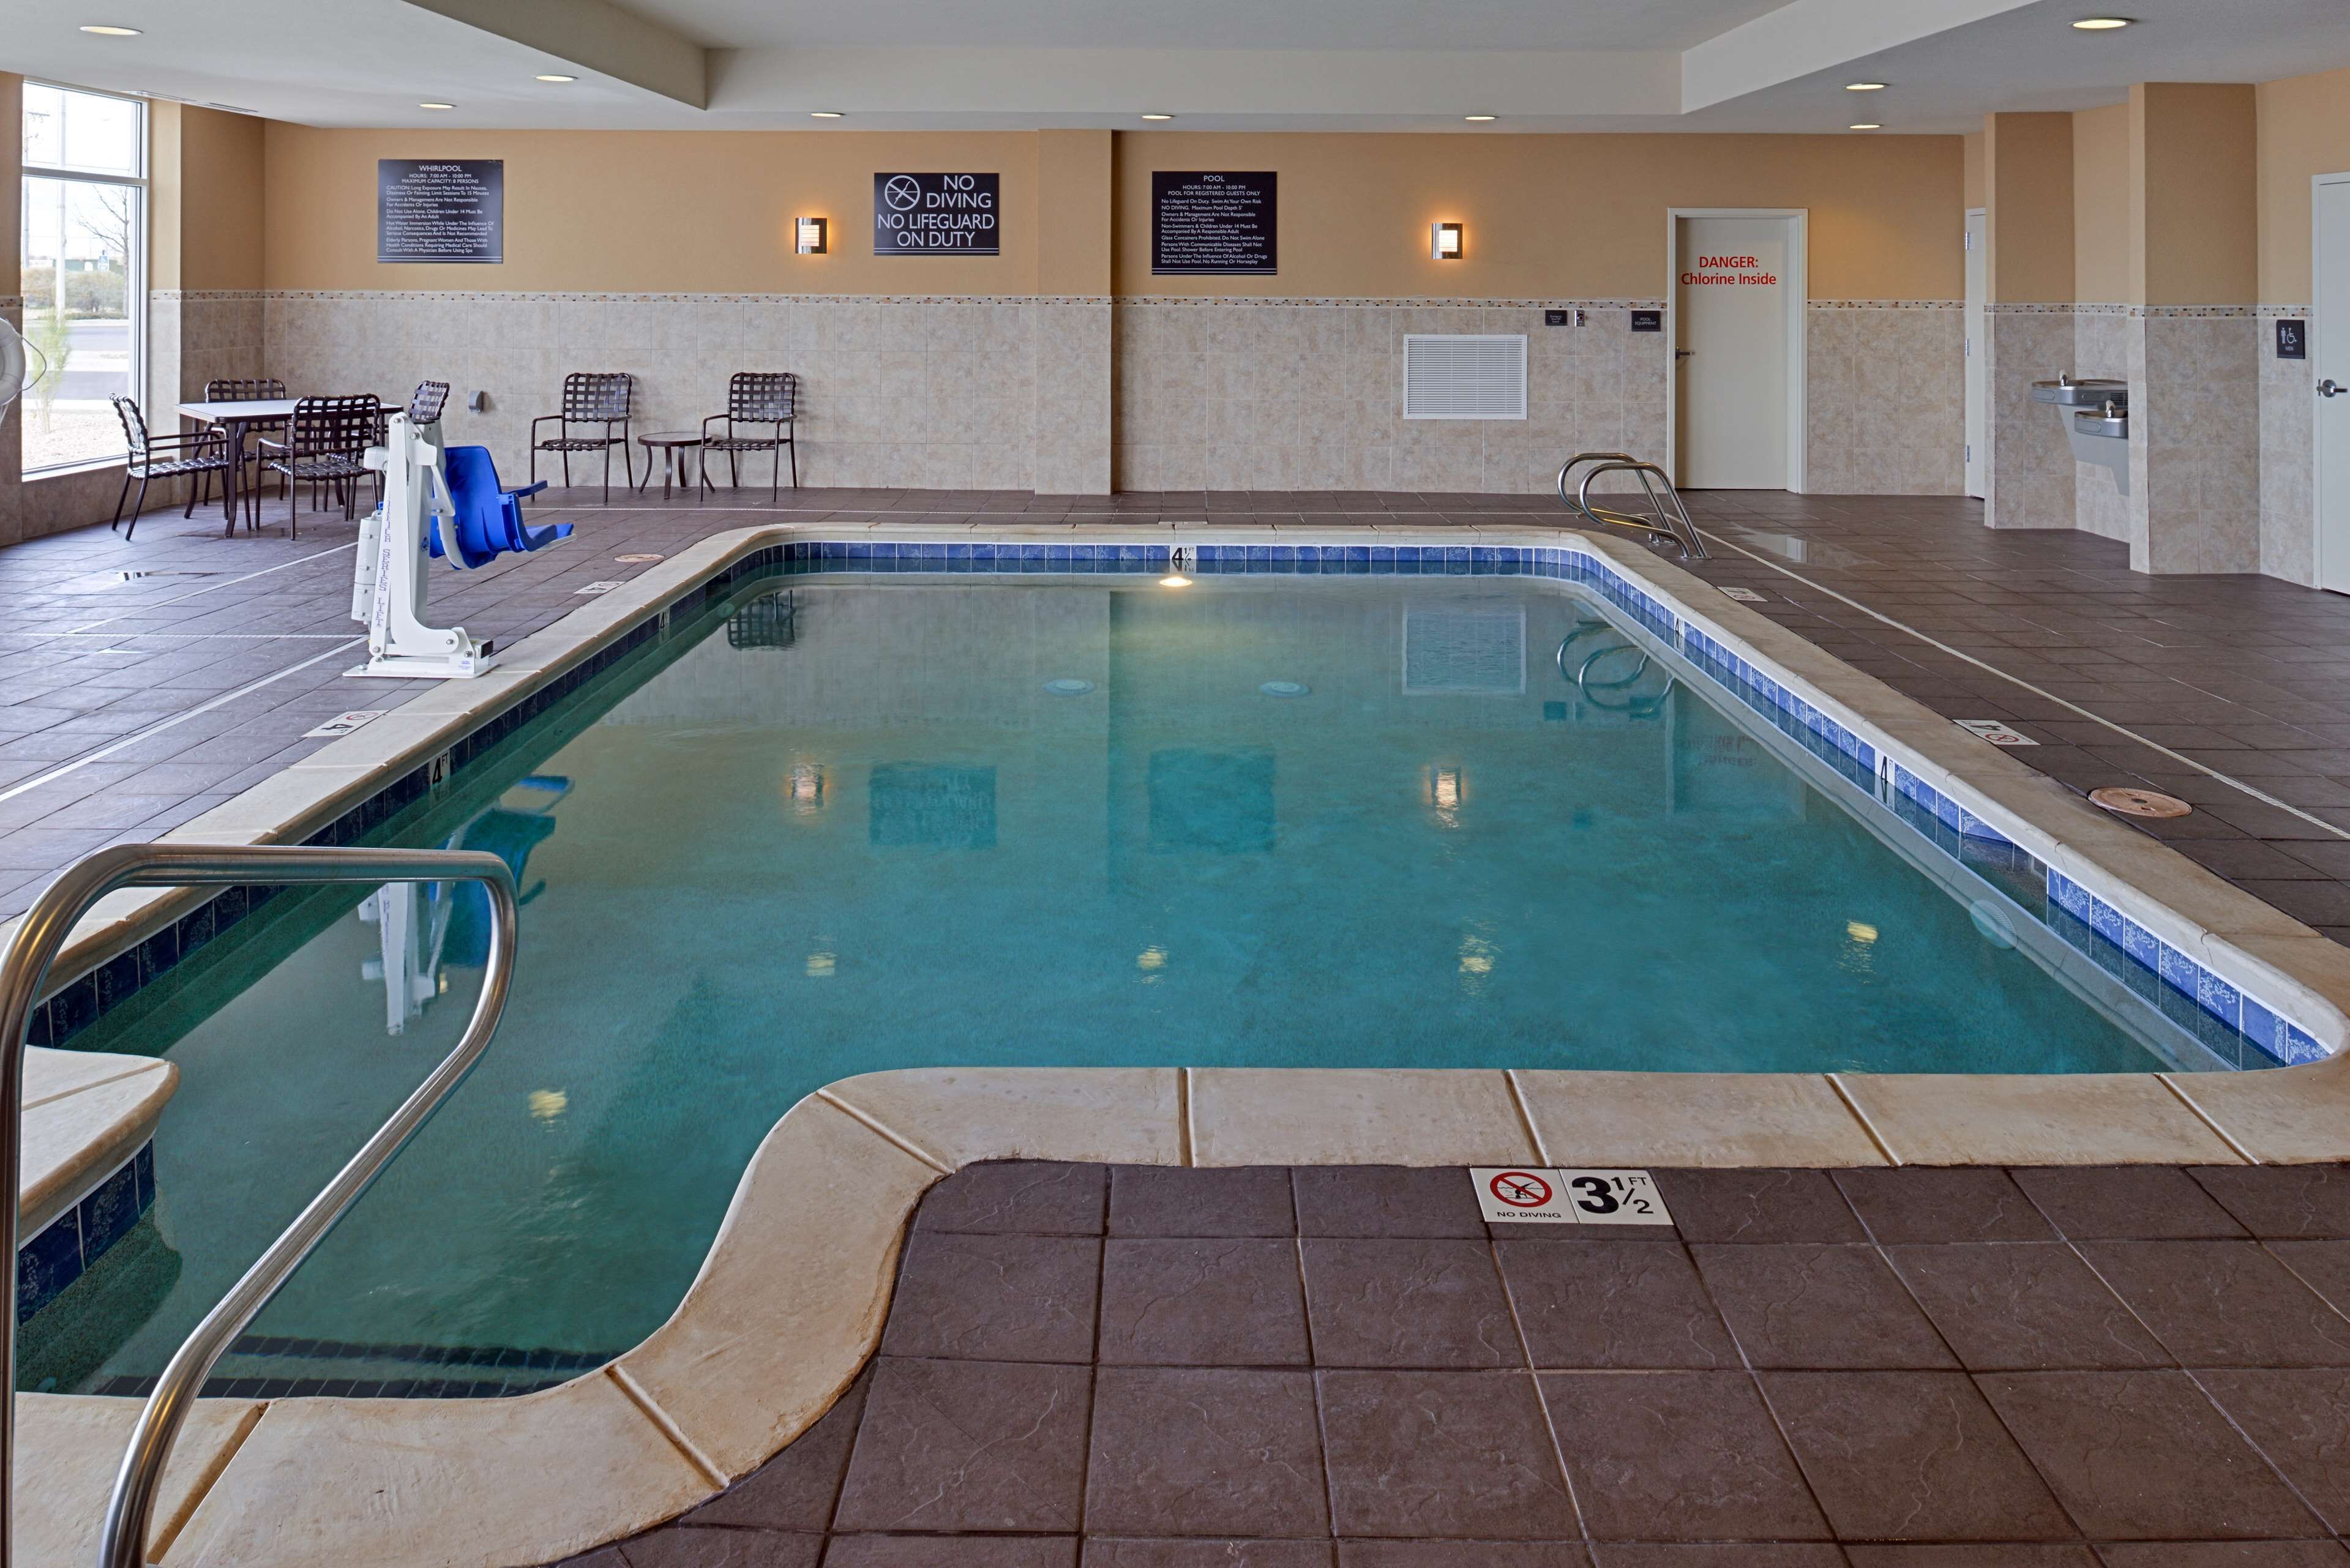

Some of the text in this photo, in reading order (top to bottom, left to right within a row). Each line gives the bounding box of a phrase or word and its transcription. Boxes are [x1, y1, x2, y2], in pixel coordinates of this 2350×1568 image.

[944, 175, 975, 190] NO
[926, 193, 992, 208] DIVING
[878, 214, 995, 229] NO LIFEGUARD
[897, 231, 975, 247] ON DUTY
[1699, 256, 1759, 268] DANGER:
[1681, 272, 1776, 285] Chlorine Inside
[1172, 547, 1184, 561] 4
[432, 752, 449, 785] 4 FT
[1880, 755, 1888, 784] 4
[1628, 1177, 1647, 1185] FT
